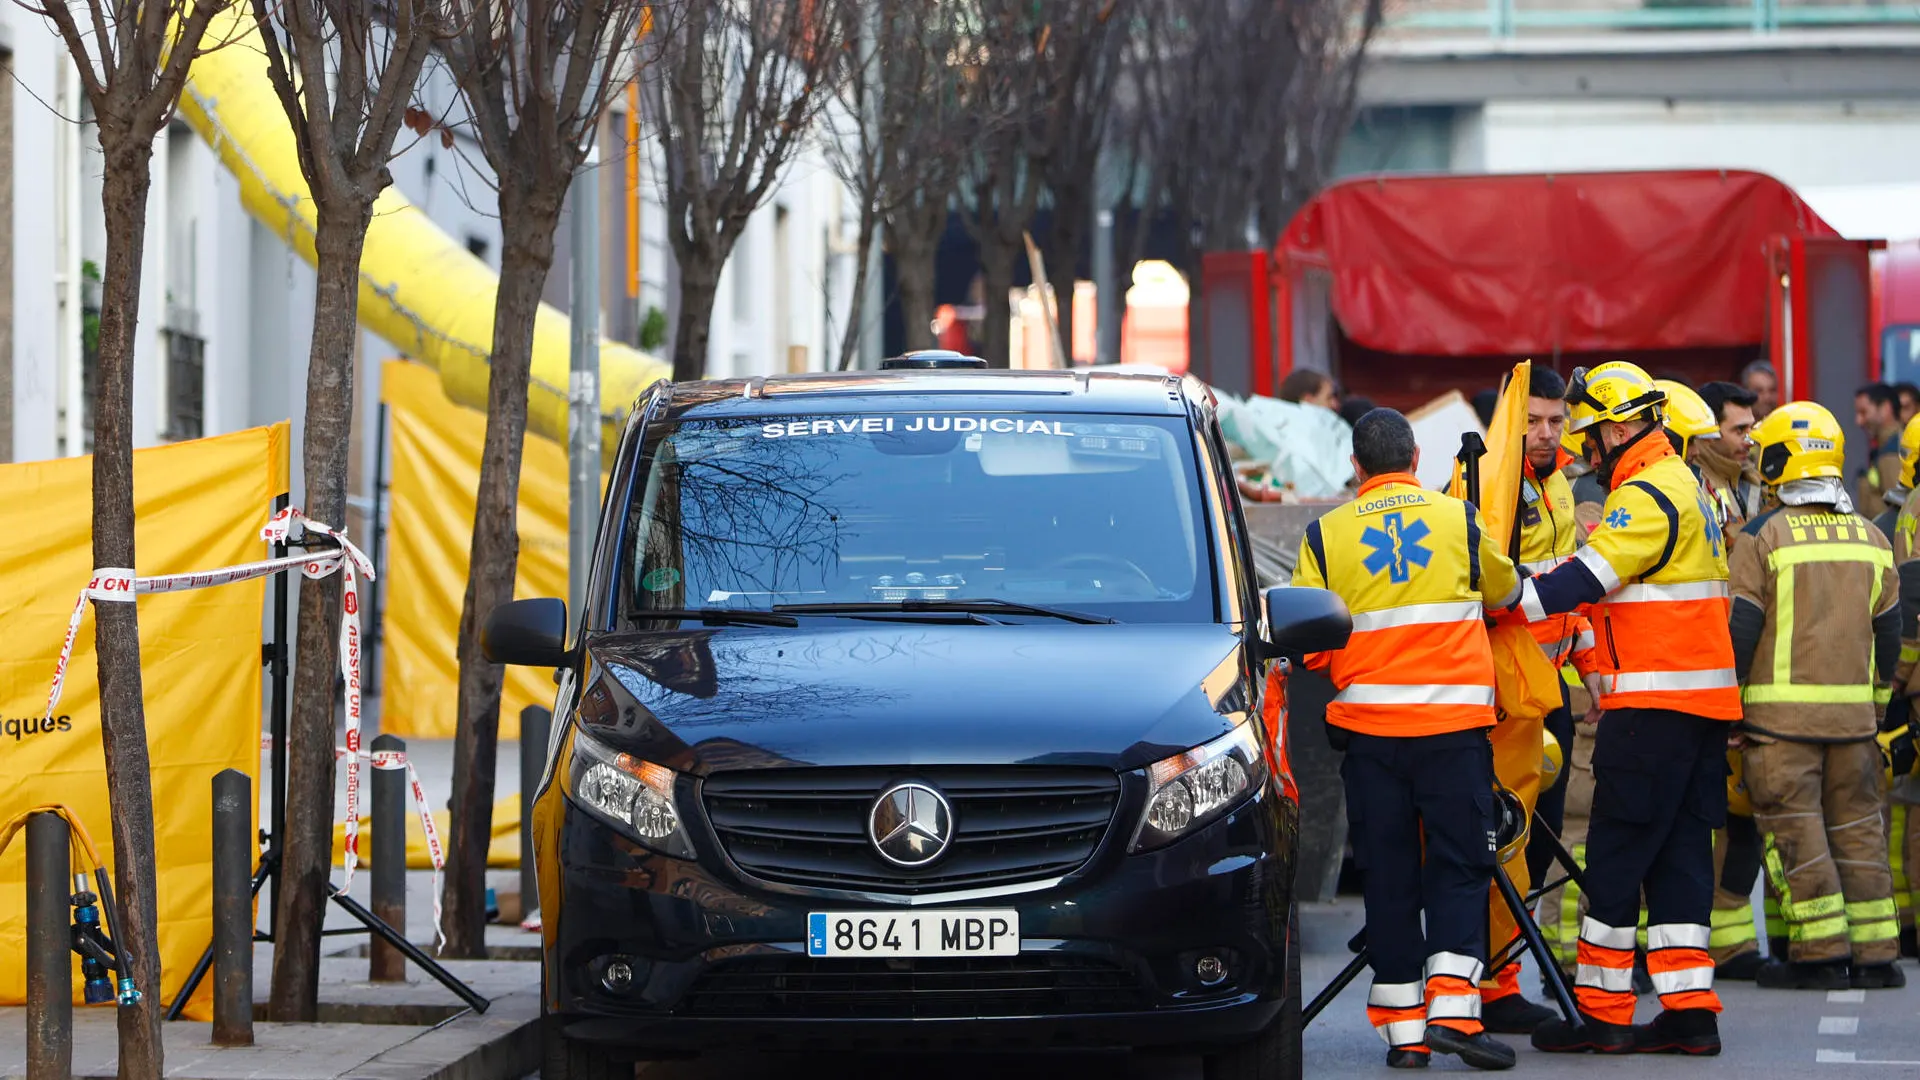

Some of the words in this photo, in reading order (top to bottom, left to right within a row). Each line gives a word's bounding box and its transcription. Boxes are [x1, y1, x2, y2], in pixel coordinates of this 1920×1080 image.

[762, 417, 893, 438] SERVEI
[905, 416, 1075, 436] JUDICIAL
[1358, 493, 1425, 514] LOGÍSTICA
[1785, 510, 1865, 528] bombers
[814, 938, 823, 948] E
[834, 918, 921, 951] 8641
[941, 918, 1009, 951] MBP
